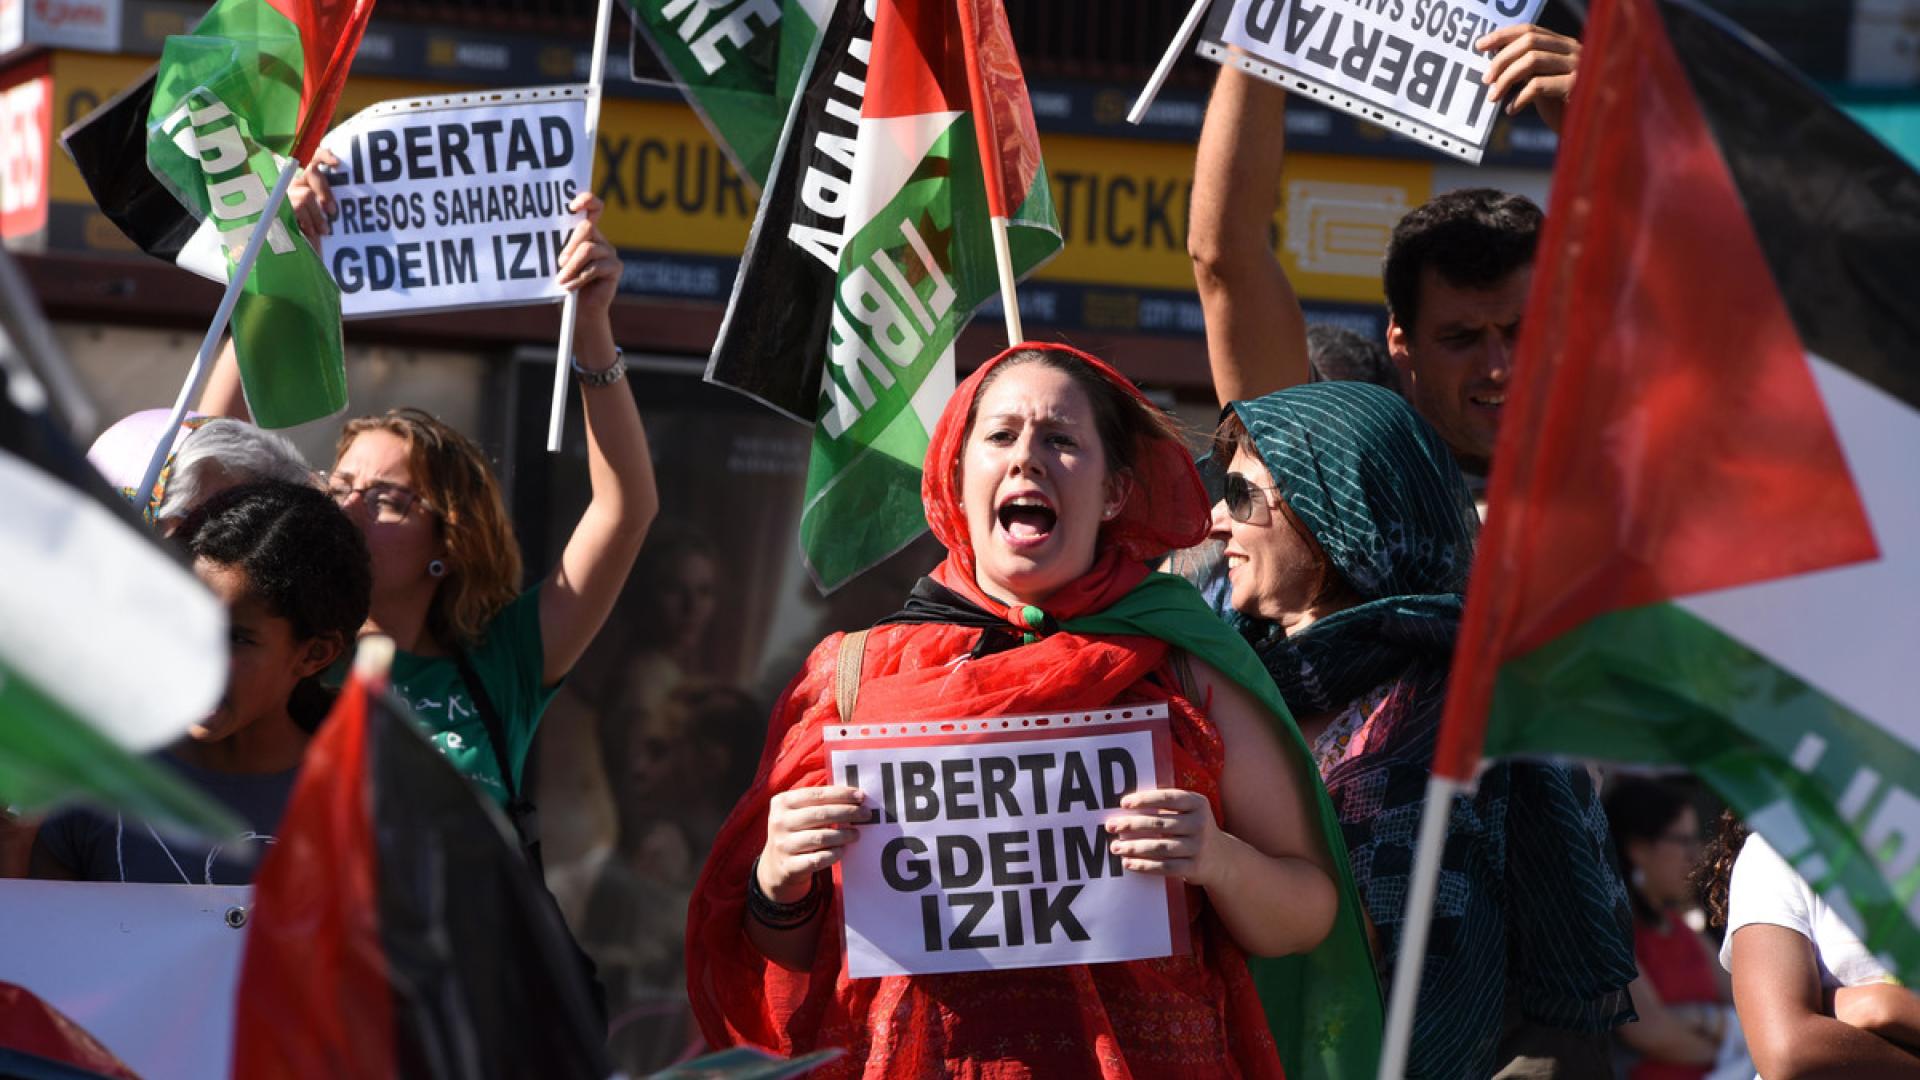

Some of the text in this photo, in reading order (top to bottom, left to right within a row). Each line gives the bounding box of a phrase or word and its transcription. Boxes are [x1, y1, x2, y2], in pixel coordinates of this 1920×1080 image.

[1244, 0, 1490, 128] LIBERTAD
[1411, 0, 1497, 61] RESOS
[433, 178, 578, 227] SAHARAUIS
[332, 237, 478, 294] GDEIM
[845, 746, 1138, 825] LIBERTAD
[880, 825, 1124, 892] GDEIM
[921, 885, 1091, 952] IZIK
